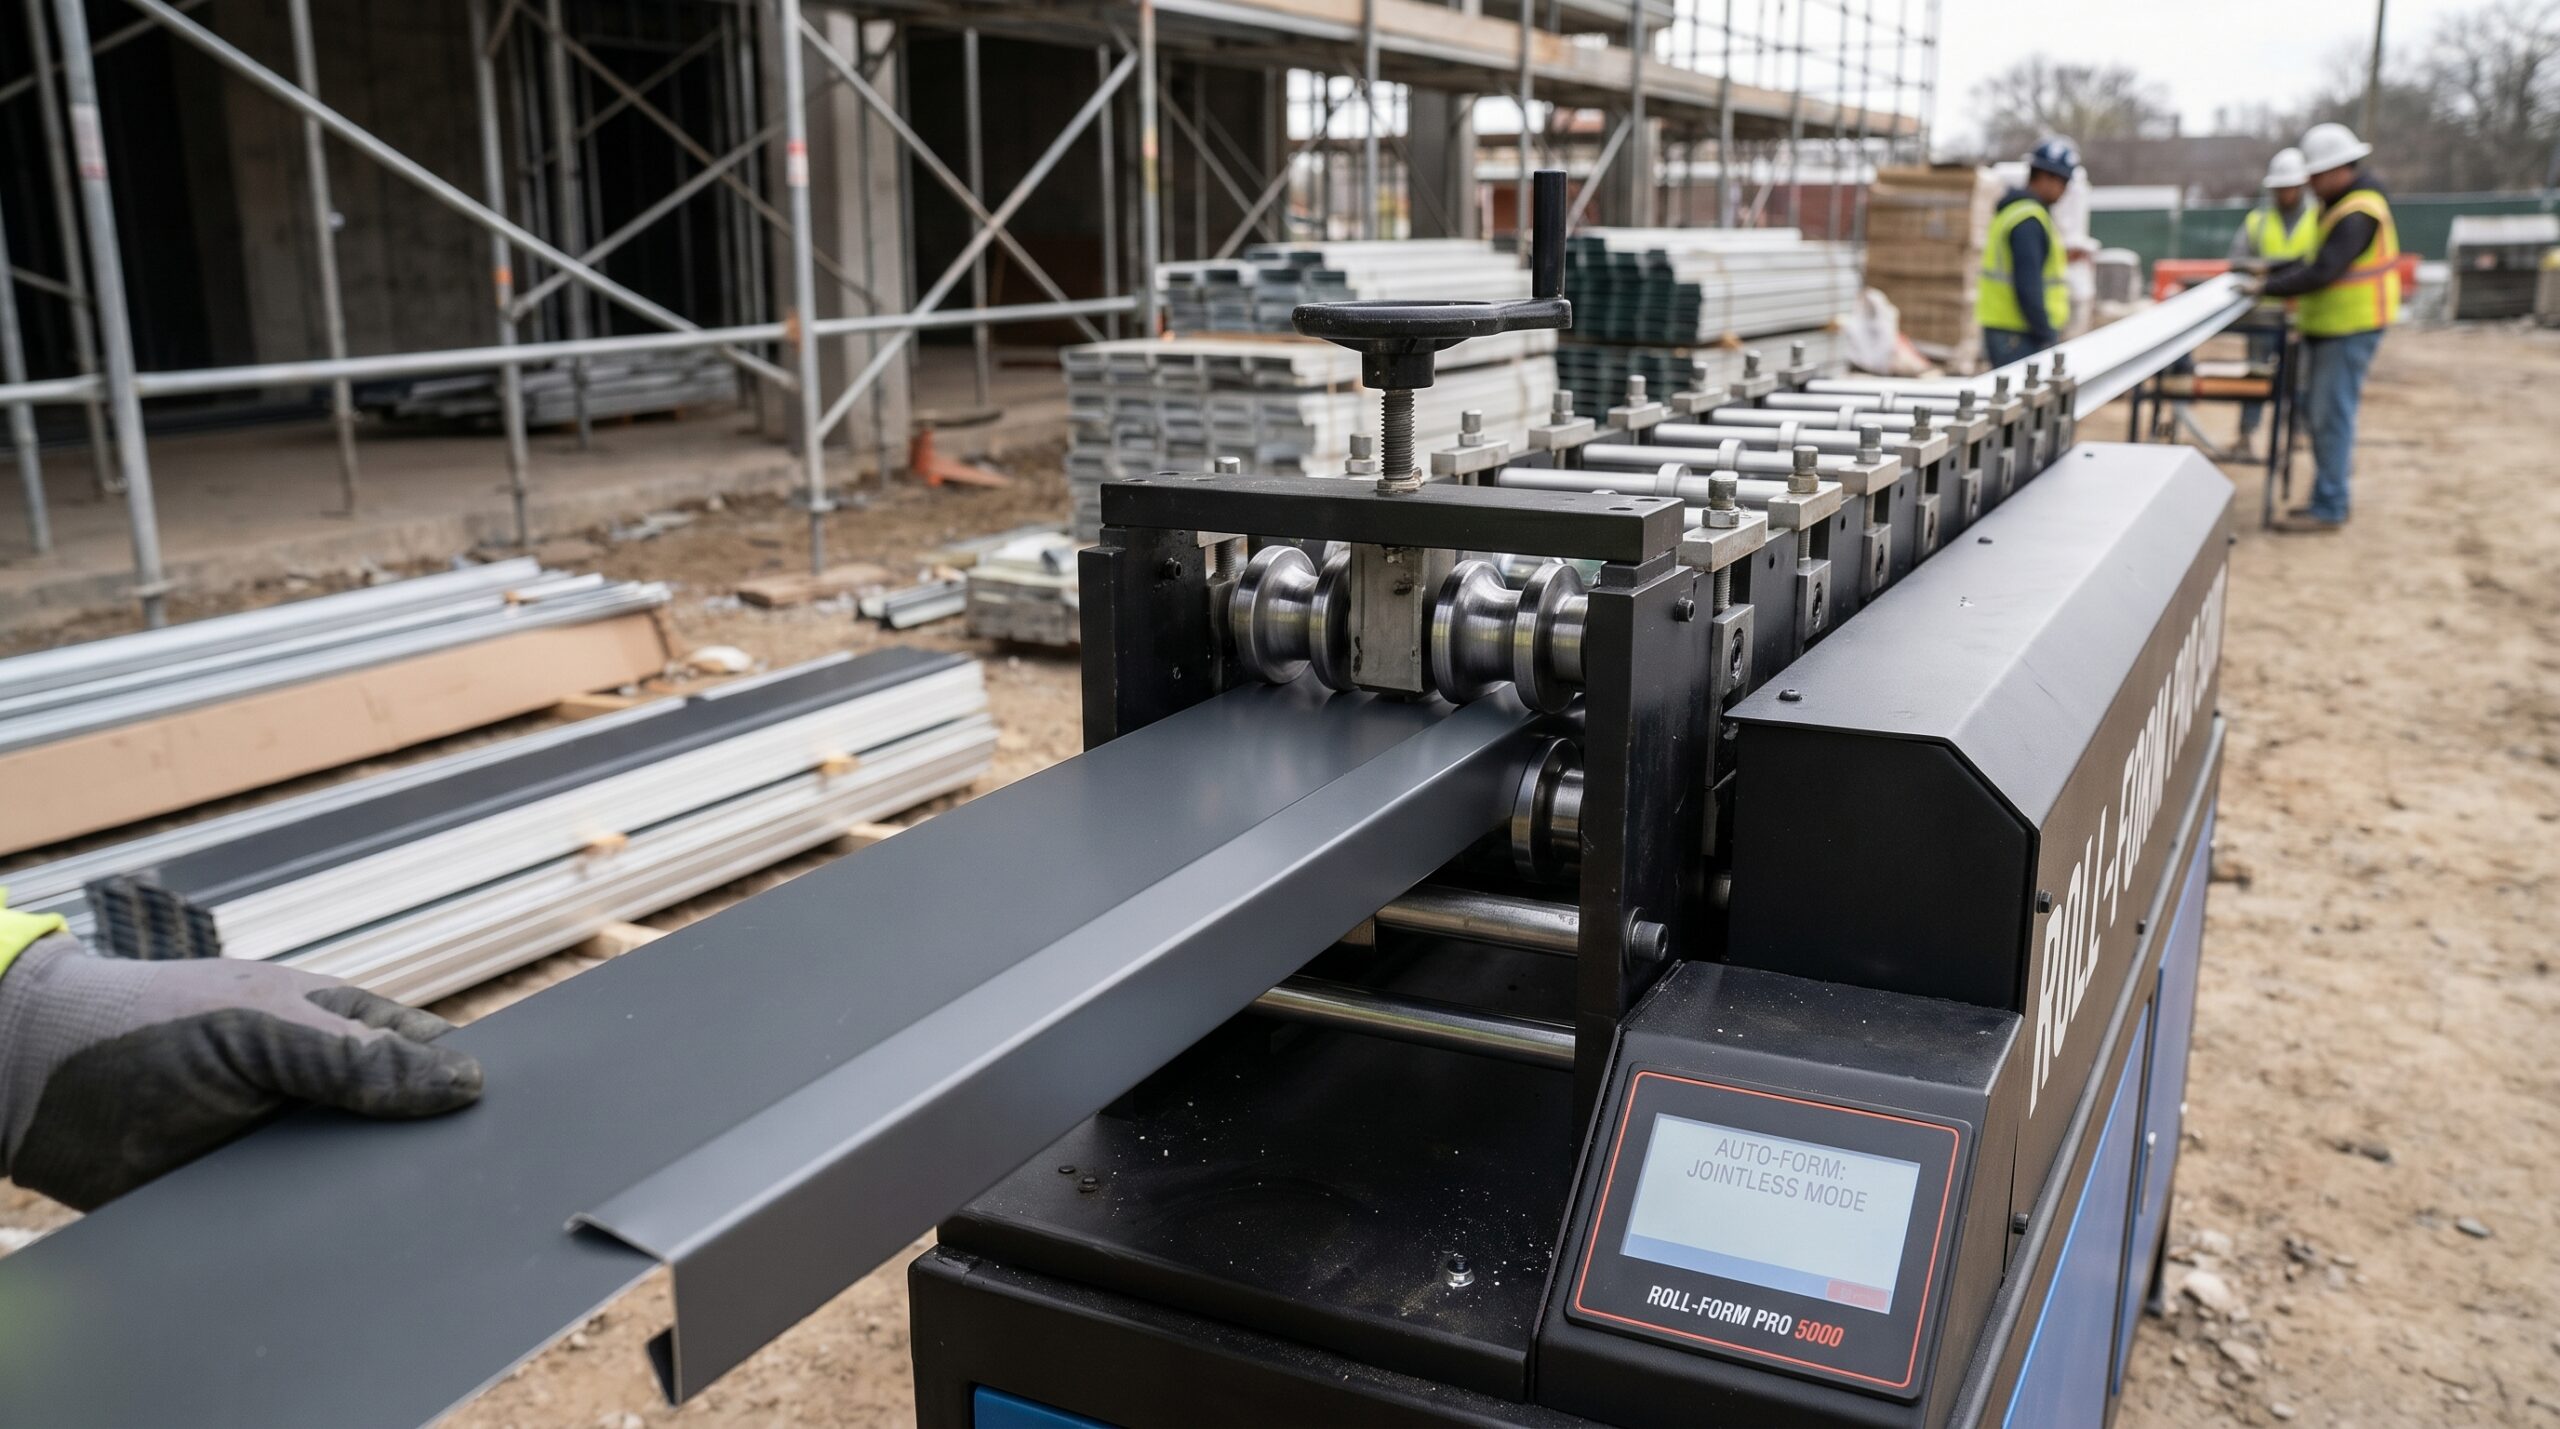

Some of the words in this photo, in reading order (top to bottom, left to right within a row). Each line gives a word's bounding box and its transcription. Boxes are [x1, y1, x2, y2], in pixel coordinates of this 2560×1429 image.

[2028, 671, 2172, 1119] ROLL-FORM
[1686, 1159, 1800, 1200] JOINTLESS
[1803, 1181, 1868, 1213] MODE
[1714, 1137, 1847, 1181] AUTO-FORM:
[1646, 1285, 1752, 1327] ROLL-FORM
[1752, 1309, 1793, 1336] PRO
[1794, 1319, 1845, 1348] 5000
